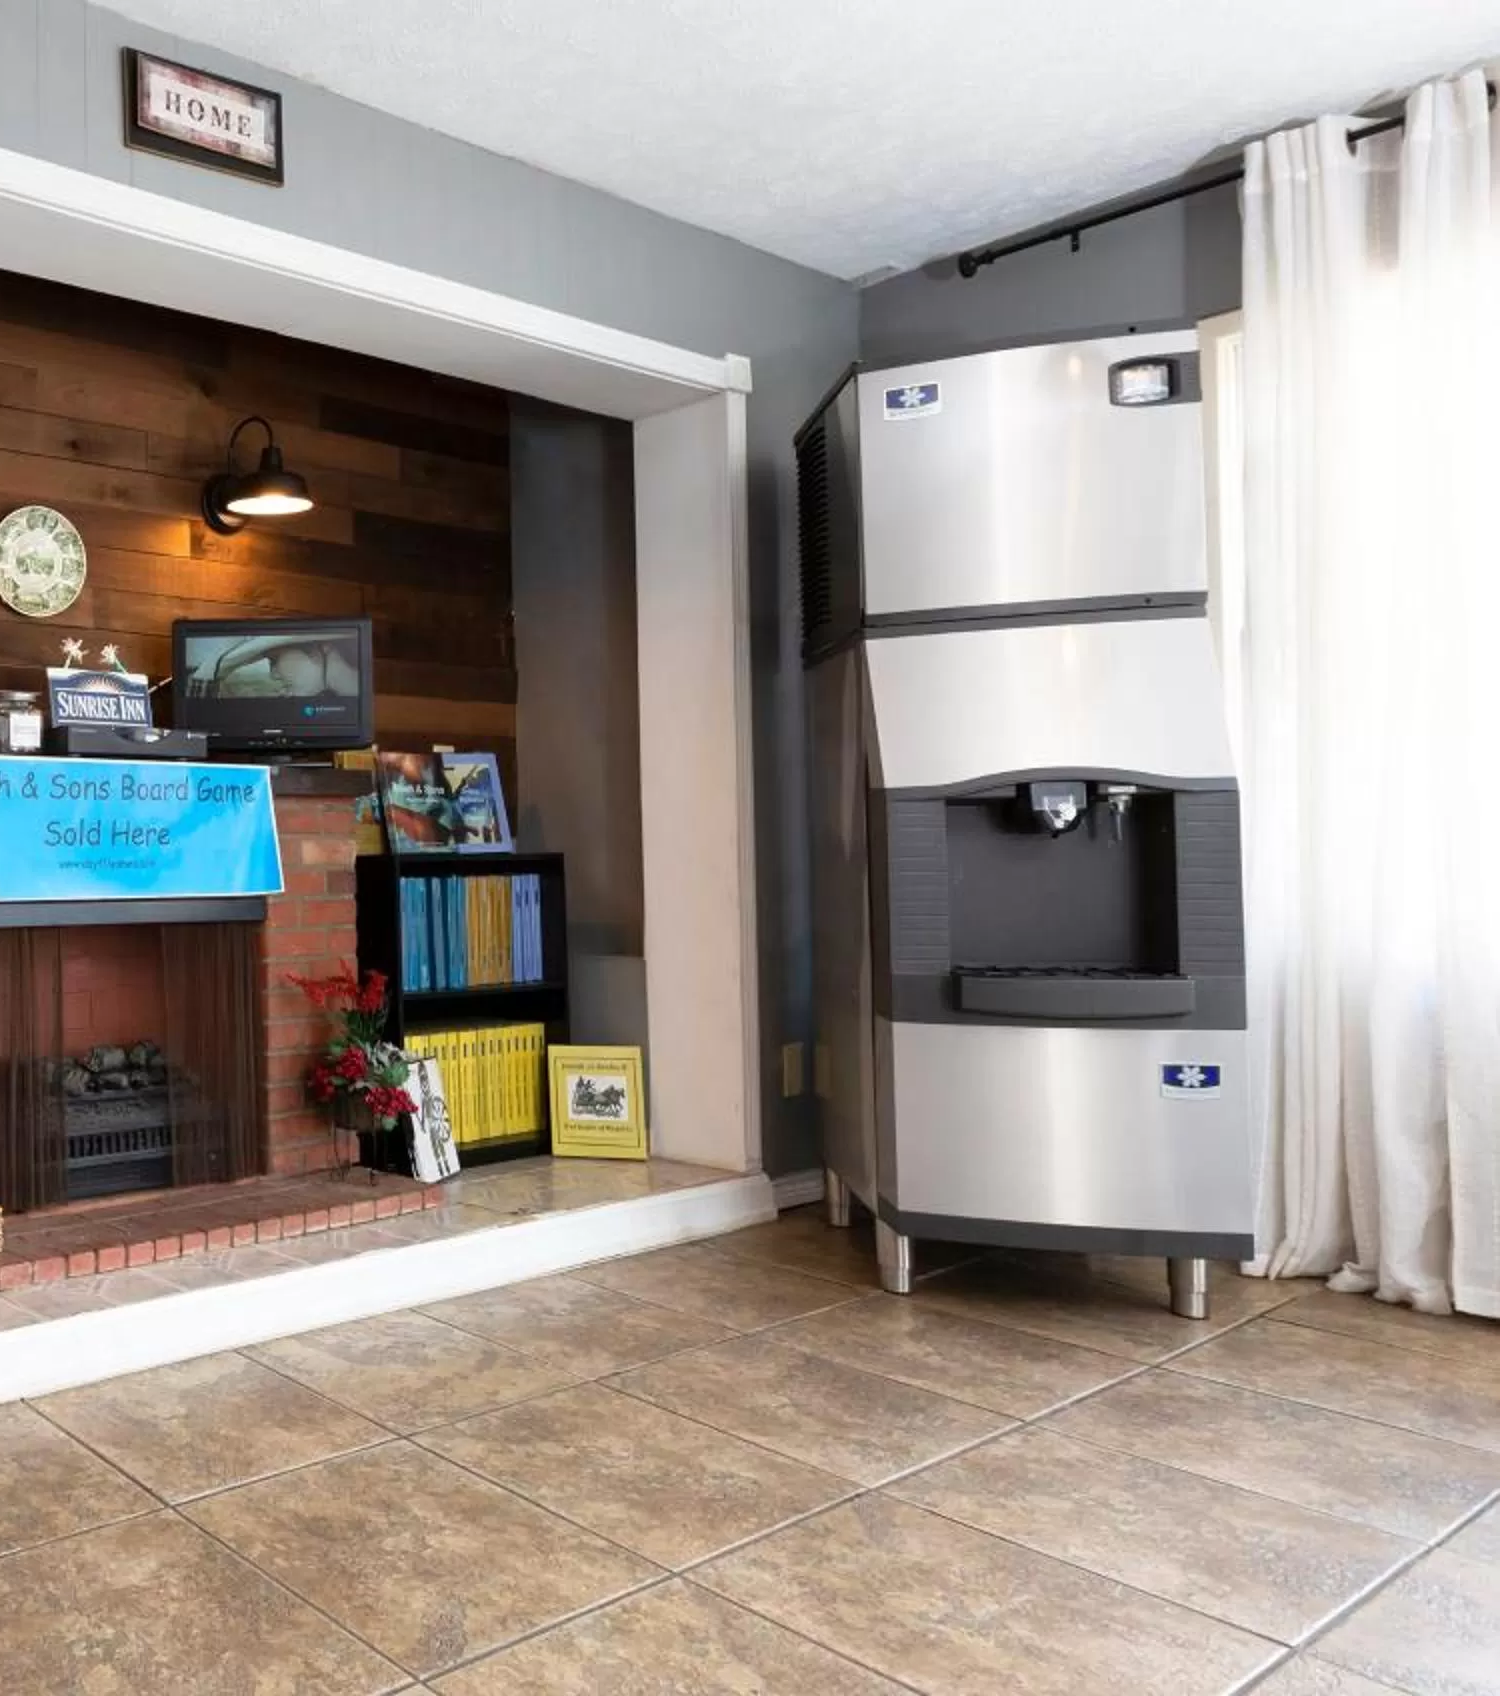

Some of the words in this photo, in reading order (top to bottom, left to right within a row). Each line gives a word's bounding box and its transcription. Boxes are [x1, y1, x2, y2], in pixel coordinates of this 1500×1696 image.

[165, 89, 251, 139] HOME
[57, 691, 120, 719] SUNRISE
[120, 695, 146, 720] INN
[20, 770, 38, 800] &
[49, 773, 111, 801] Sons
[121, 774, 190, 801] Board
[197, 776, 255, 805] Game
[43, 819, 102, 847] Sold
[111, 822, 171, 847] Here
